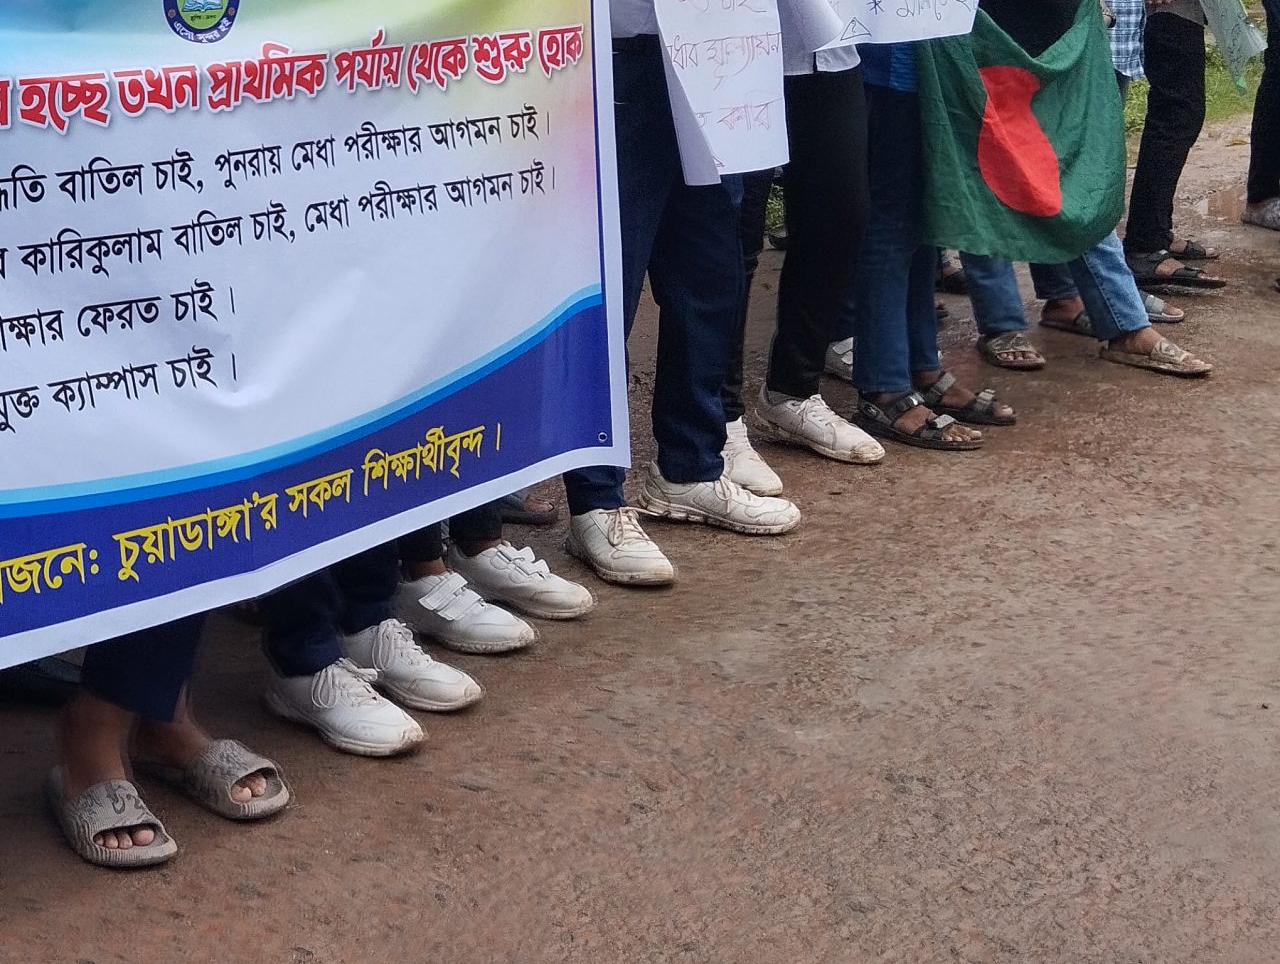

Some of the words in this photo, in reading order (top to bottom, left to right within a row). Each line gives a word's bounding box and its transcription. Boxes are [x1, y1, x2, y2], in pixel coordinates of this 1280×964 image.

[18, 71, 109, 131] হচ্ছে
[118, 64, 198, 114] তখন
[206, 43, 327, 111] প্রাথমিক
[333, 29, 405, 90] পর্যায়
[406, 38, 467, 91] থেকে
[472, 31, 532, 82] শুরু
[537, 25, 585, 78] হোক
[55, 156, 144, 204] বাতিল
[153, 148, 204, 194] চাই,
[215, 143, 282, 189] পুনরায়
[292, 134, 336, 173] মেধা
[344, 121, 422, 163] পরীক্ষার
[428, 114, 501, 151] আগমন
[18, 227, 163, 276] কারিকুলাম
[171, 210, 243, 257] বাতিল
[250, 199, 296, 243] চাই,
[304, 192, 351, 234] মেধা
[357, 179, 437, 220] পরীক্ষার
[445, 171, 513, 208] আগমন
[77, 295, 162, 340] ফেরত
[47, 362, 159, 412] ক্যাম্পাস
[285, 468, 354, 519] সকল
[361, 424, 486, 497] শিক্ষার্থীবৃন্দ
